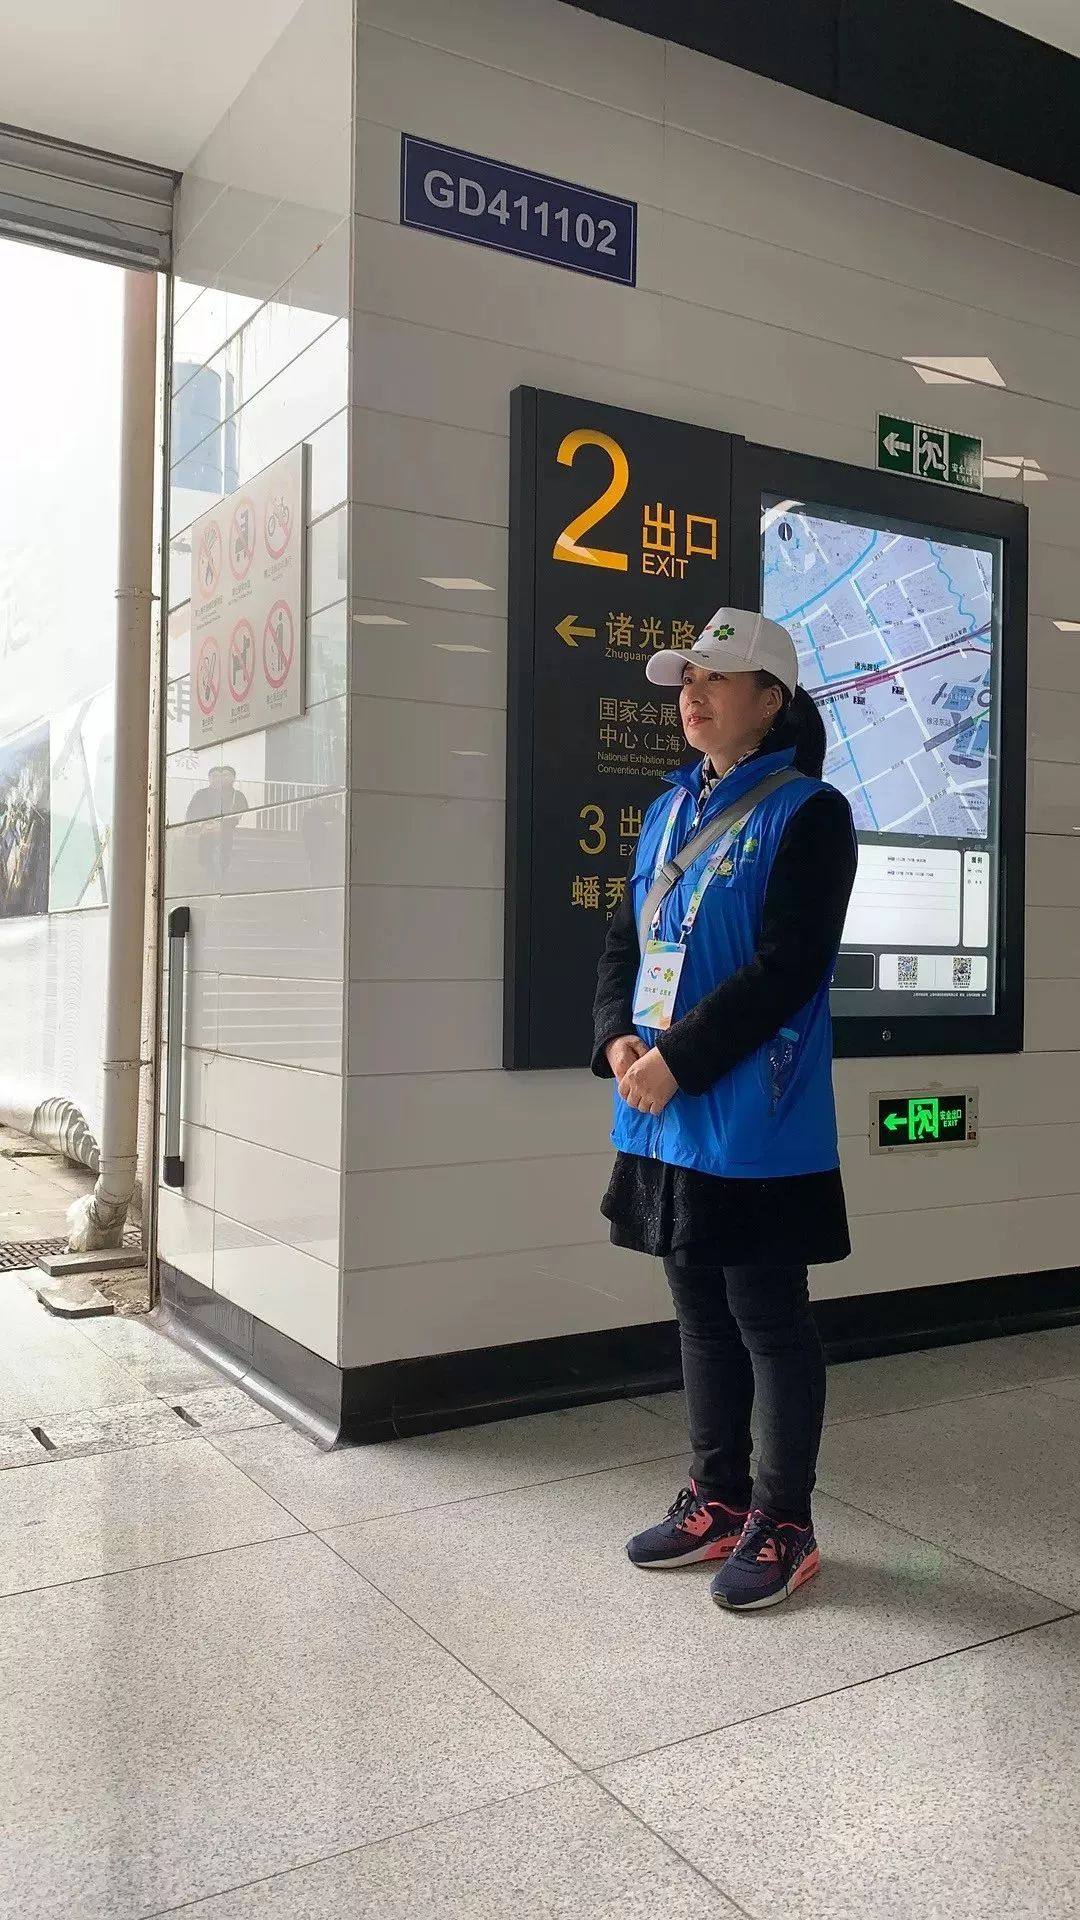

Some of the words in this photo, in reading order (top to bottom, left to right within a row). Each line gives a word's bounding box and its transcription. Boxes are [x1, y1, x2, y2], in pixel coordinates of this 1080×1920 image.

[423, 169, 617, 256] GD411102
[553, 428, 629, 571] 2
[642, 502, 717, 560] 出口
[642, 554, 689, 580] EXIT
[606, 612, 697, 650] 诸光路
[599, 697, 678, 727] 国家会展
[597, 751, 629, 762] National
[630, 753, 665, 765] Exhibition
[666, 756, 681, 766] and
[597, 763, 640, 775] Convention
[641, 767, 666, 777] Center
[579, 804, 607, 855] 3
[620, 806, 642, 837] 出
[571, 875, 627, 909] 蟠秀
[939, 1109, 962, 1121] 安全出口
[943, 1119, 958, 1128] EXIT
